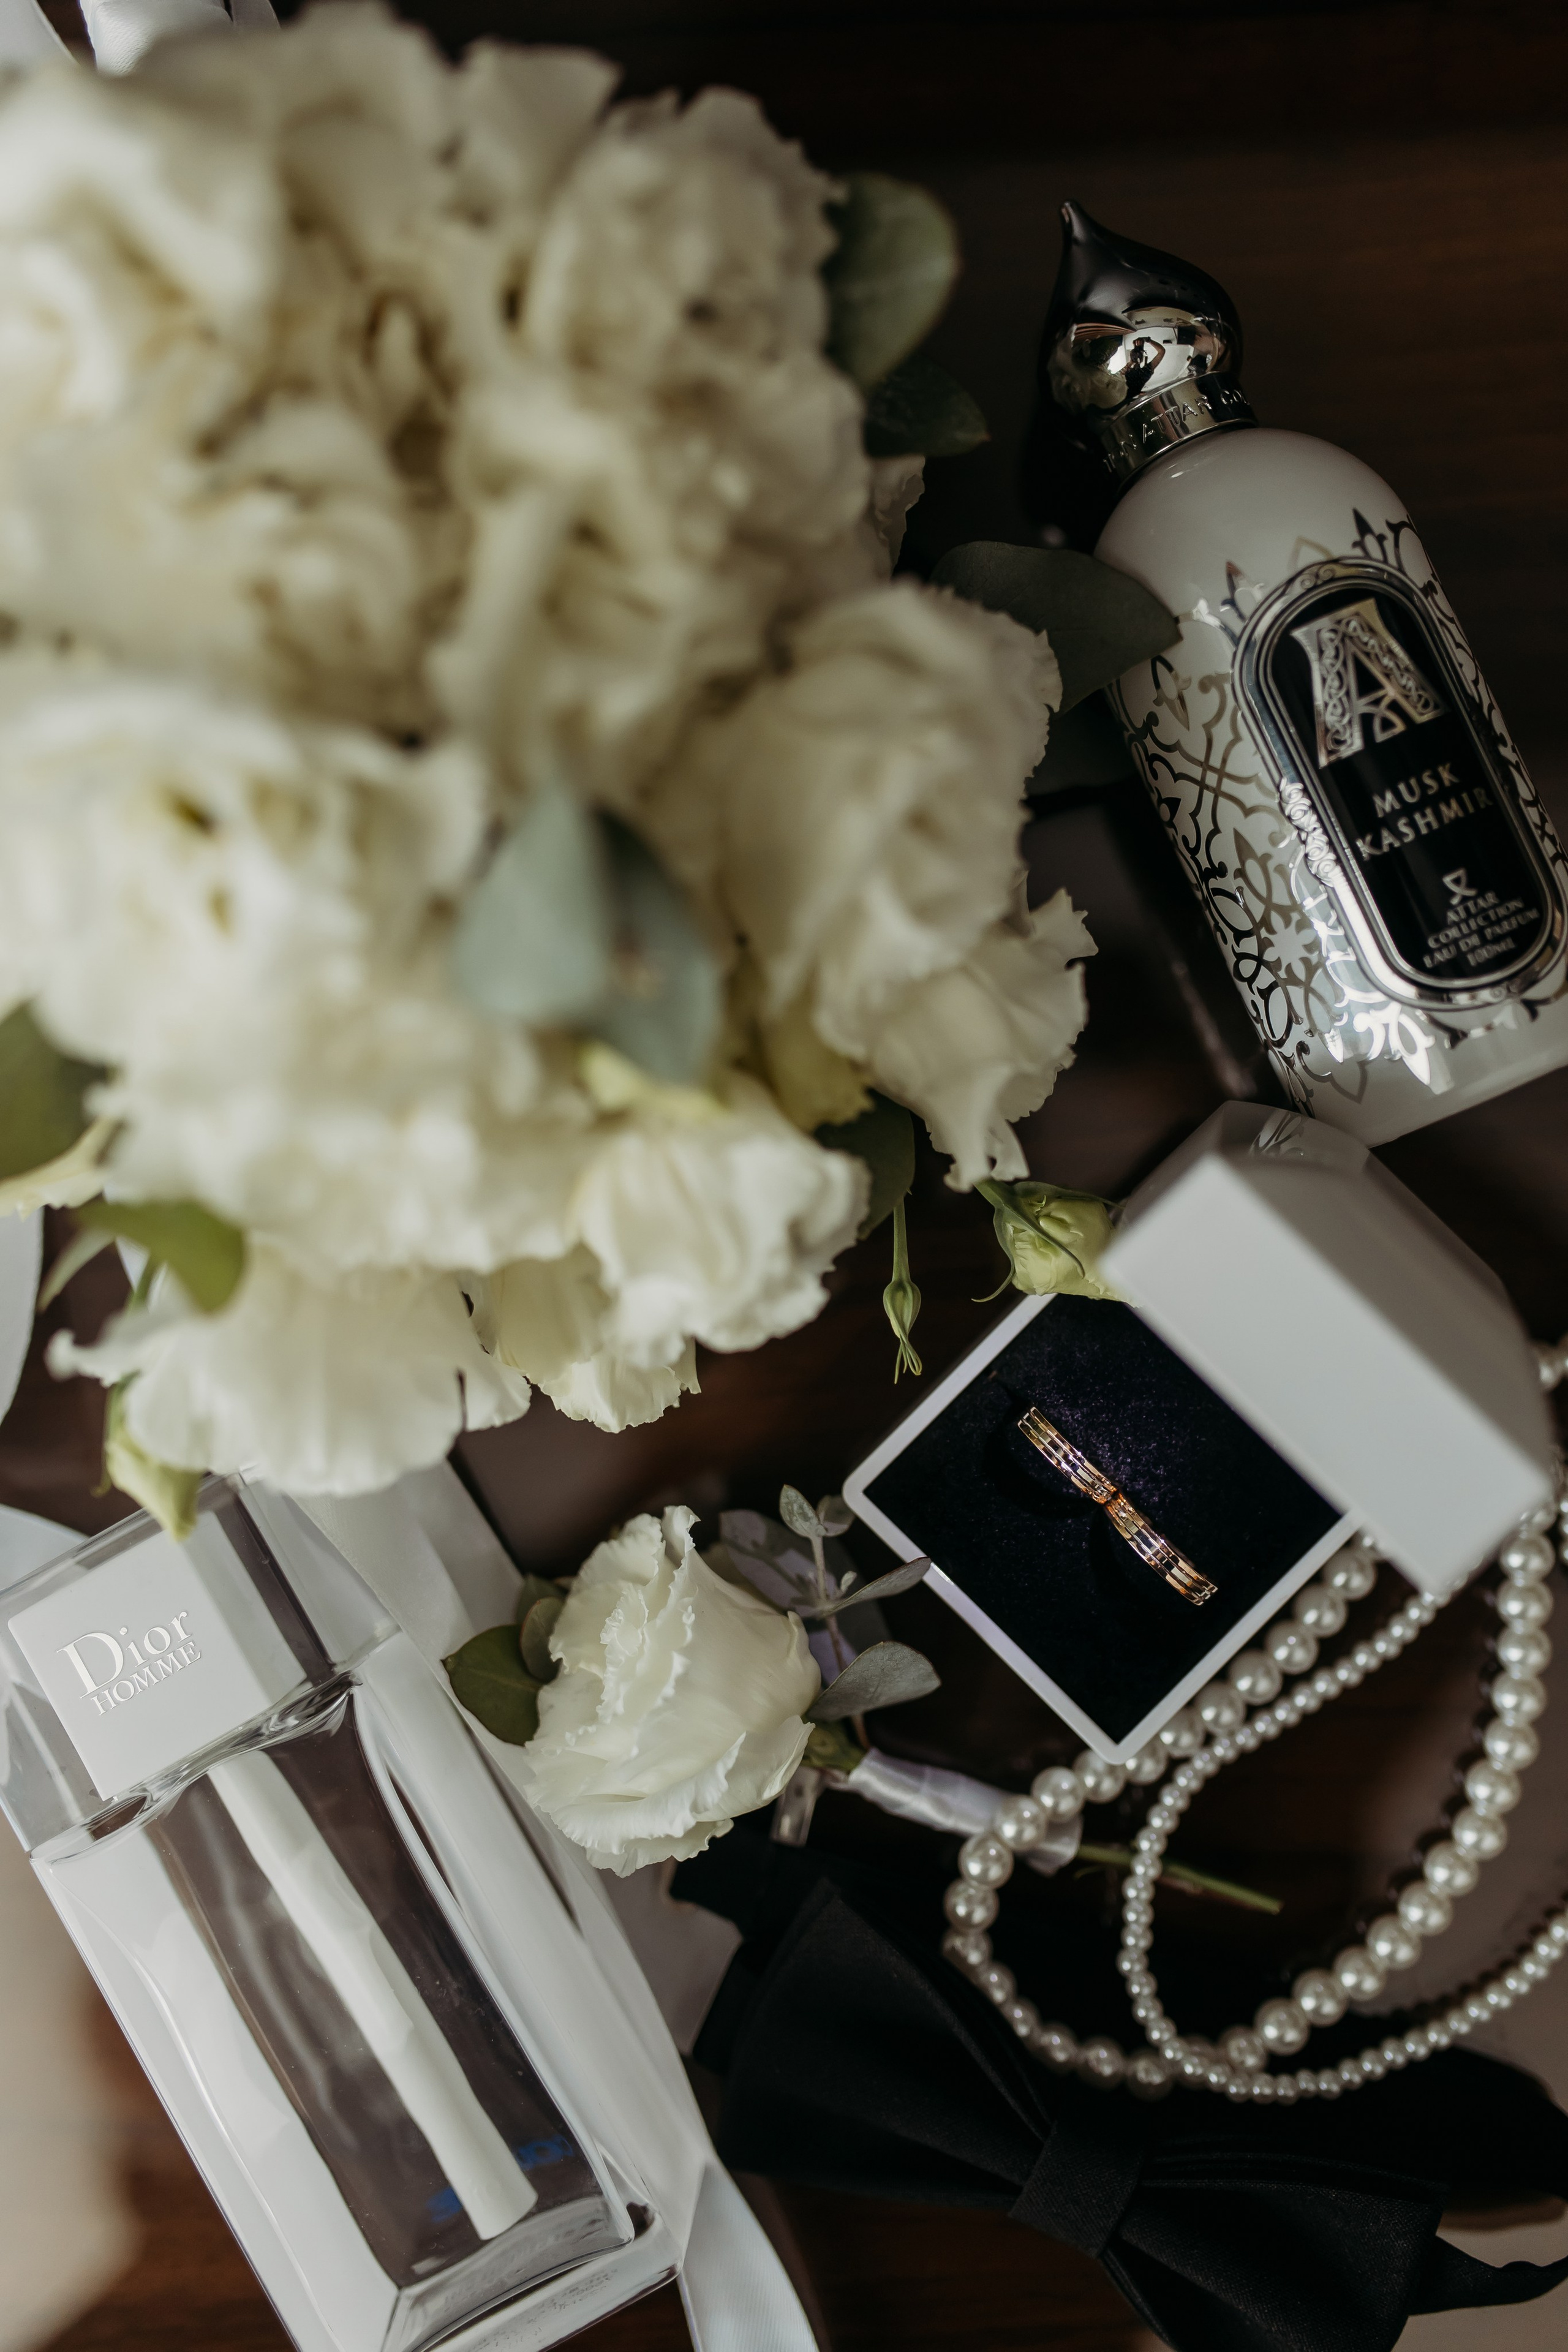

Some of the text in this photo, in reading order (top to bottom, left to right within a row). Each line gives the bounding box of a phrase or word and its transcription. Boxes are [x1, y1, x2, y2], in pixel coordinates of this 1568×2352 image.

[1142, 394, 1212, 443] ATTAR
[1373, 763, 1460, 818] MUSK
[1355, 787, 1493, 861] KASHMIR
[1427, 897, 1525, 949] COLLECTION
[1447, 890, 1499, 925] ATTAR
[1422, 943, 1458, 968] EAU
[56, 1610, 193, 1699] Dior
[90, 1641, 202, 1716] HOMME
